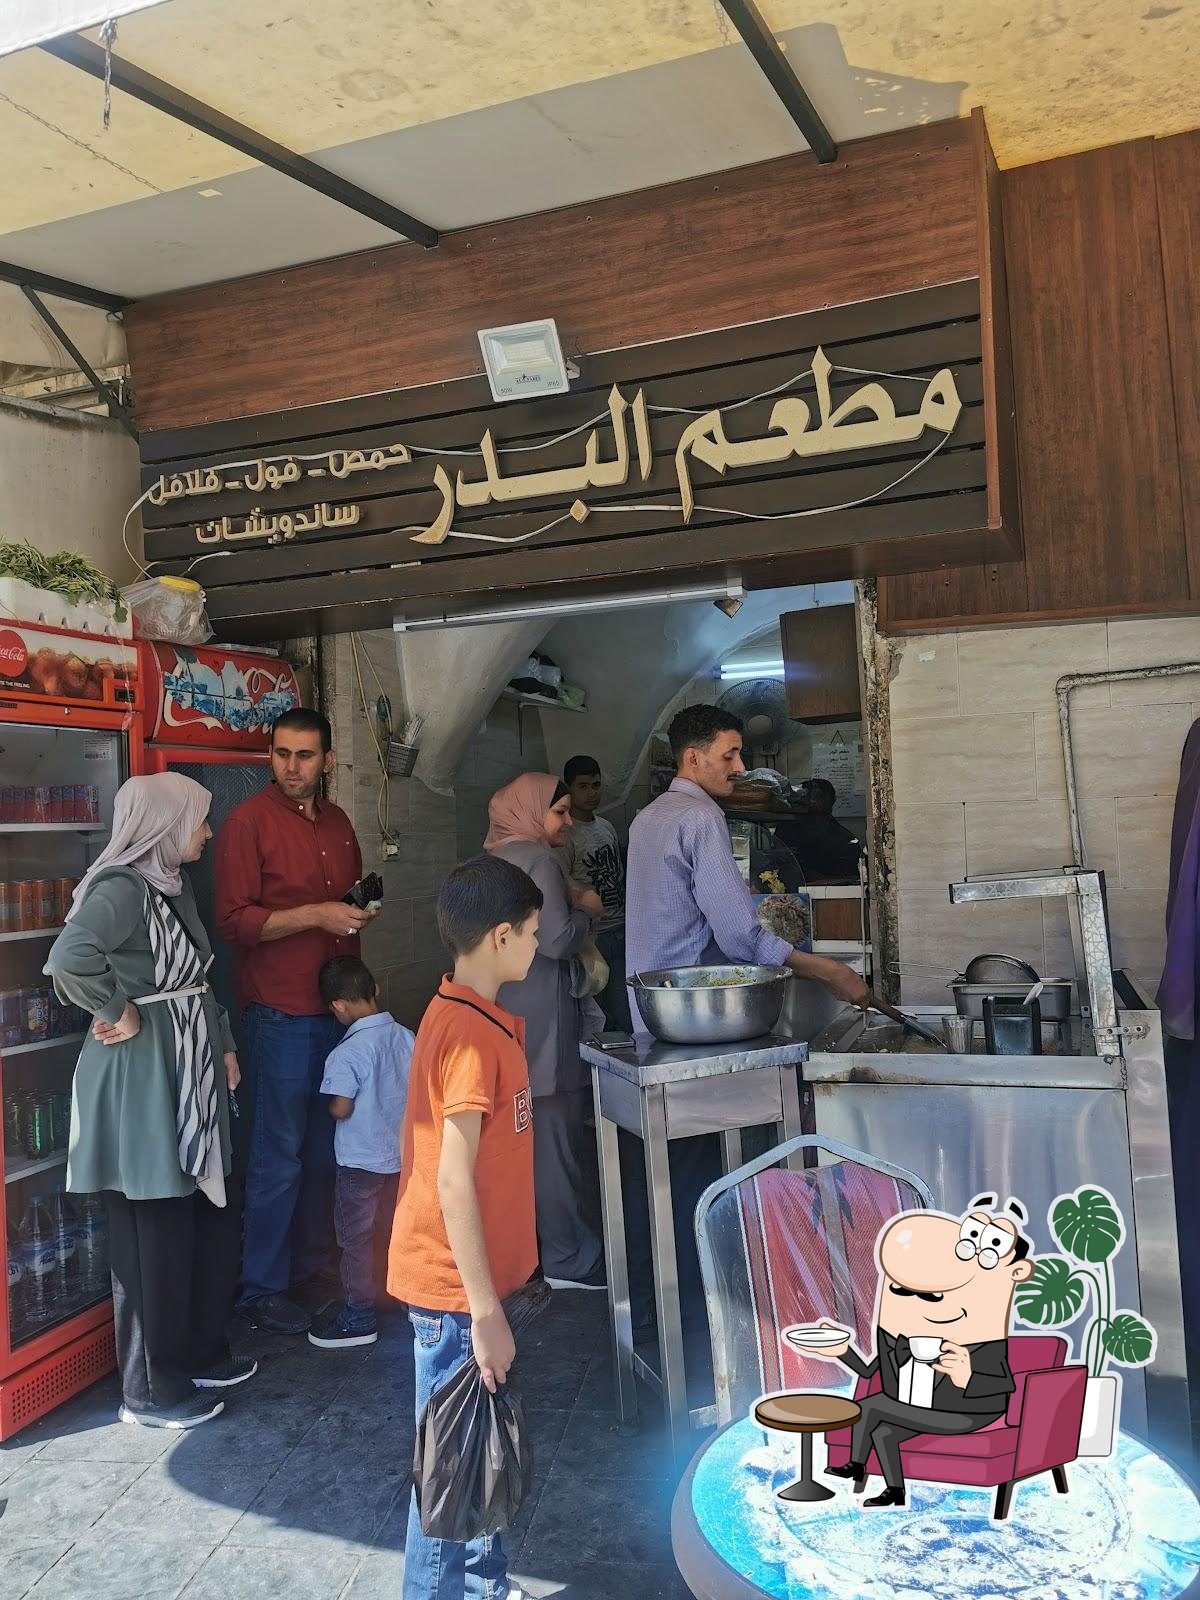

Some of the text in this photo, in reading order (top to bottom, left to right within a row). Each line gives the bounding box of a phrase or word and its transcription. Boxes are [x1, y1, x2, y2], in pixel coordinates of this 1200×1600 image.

[328, 443, 412, 480] حمص
[409, 345, 963, 545] مطعم البدر
[149, 468, 223, 505] فلافل
[244, 456, 302, 493] فول
[195, 502, 362, 545] ساندويشات
